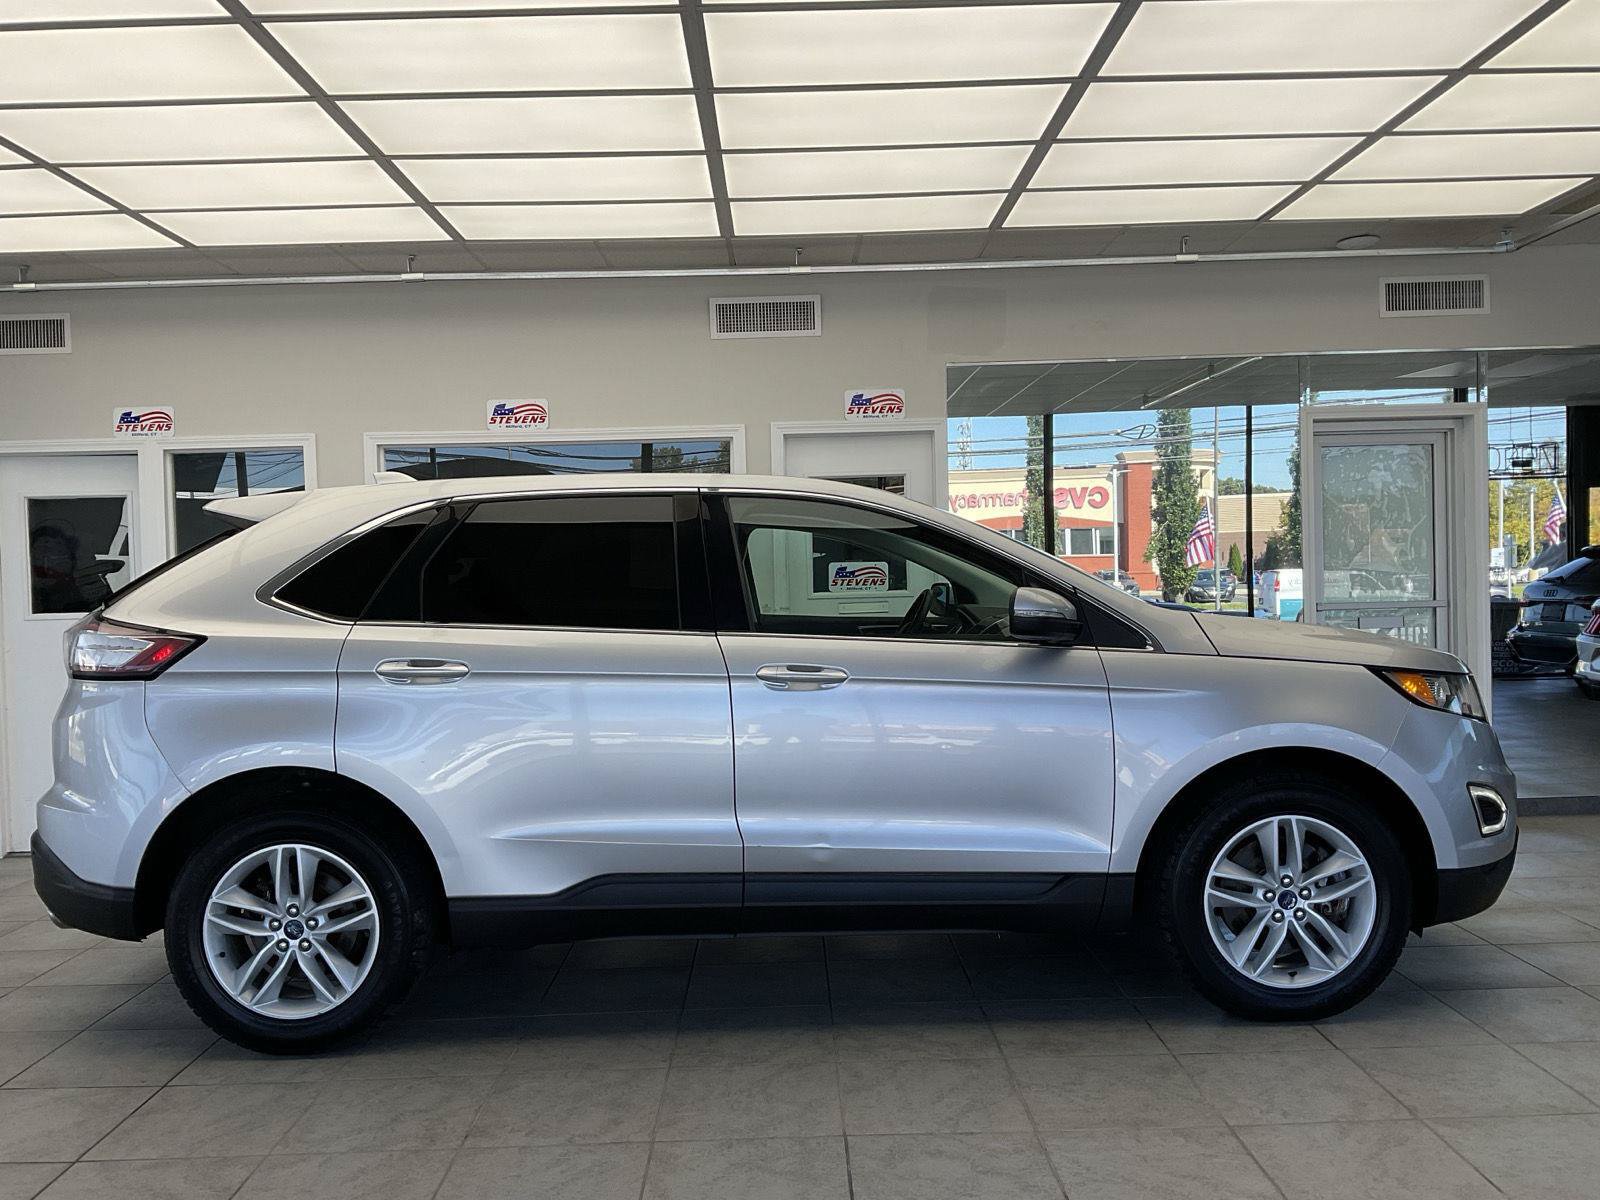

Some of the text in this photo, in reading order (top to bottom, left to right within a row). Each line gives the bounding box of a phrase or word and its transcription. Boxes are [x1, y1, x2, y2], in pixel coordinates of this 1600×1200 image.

[847, 405, 904, 414] STEVENS
[489, 416, 547, 424] STEVENS
[115, 424, 172, 432] STEVENS
[831, 578, 887, 586] STEVENS
